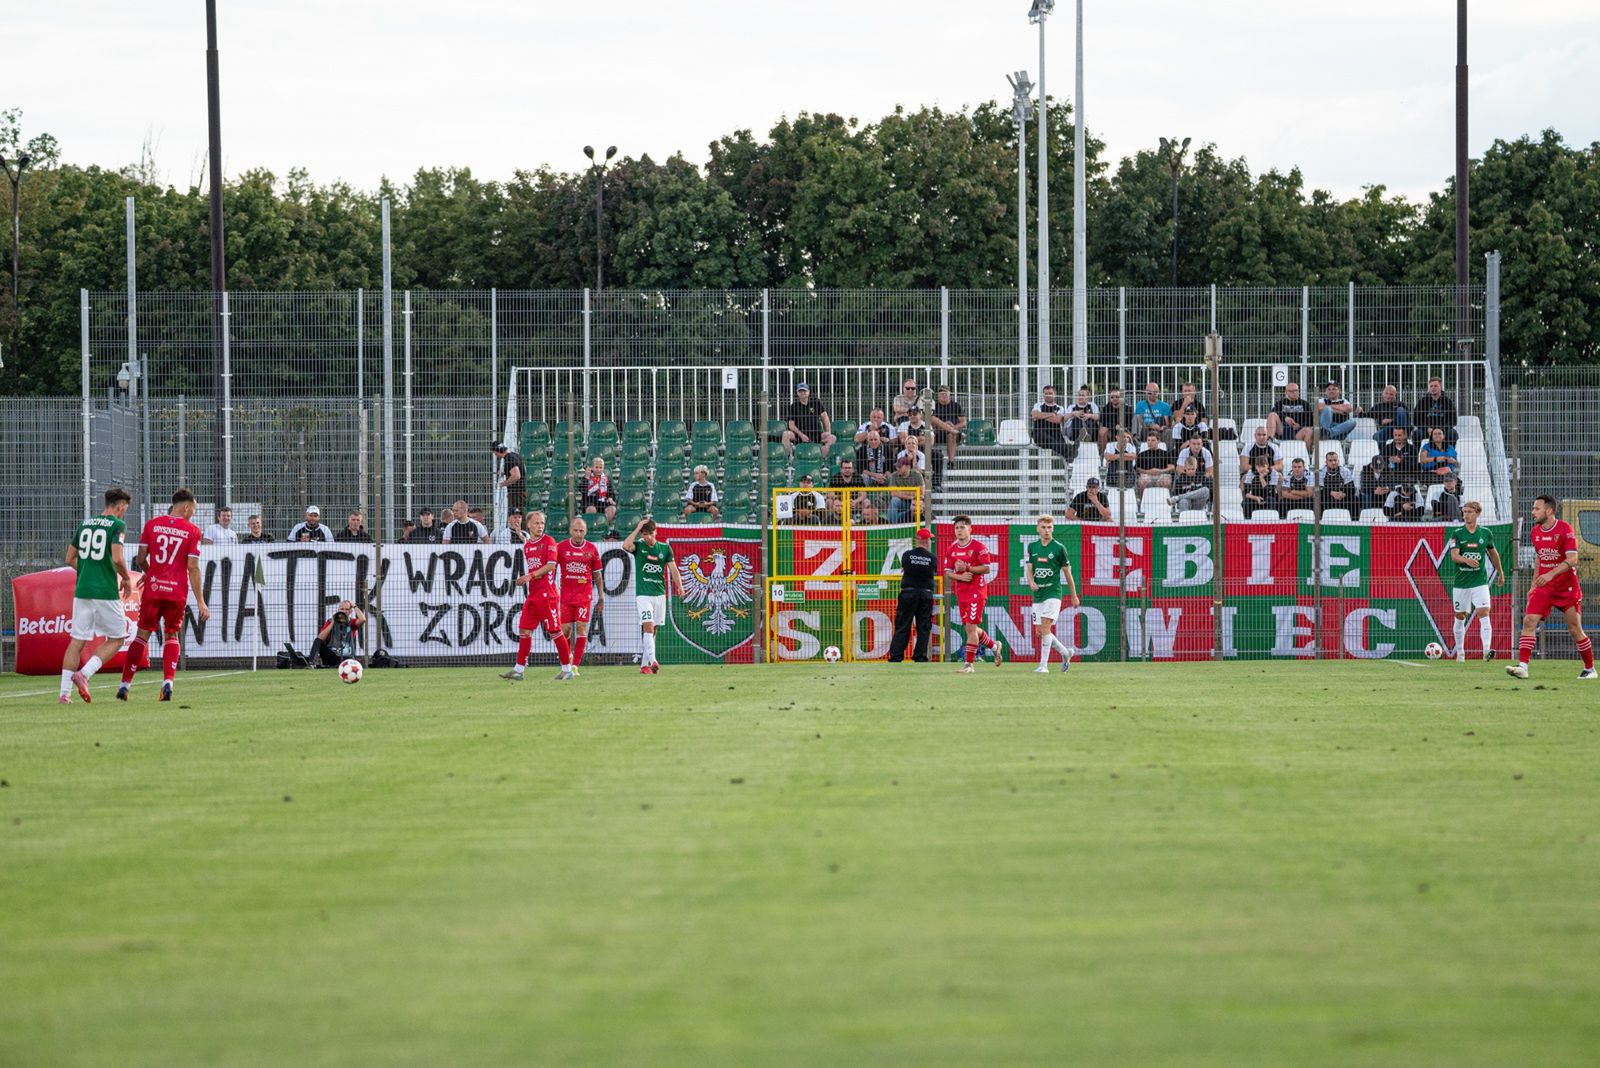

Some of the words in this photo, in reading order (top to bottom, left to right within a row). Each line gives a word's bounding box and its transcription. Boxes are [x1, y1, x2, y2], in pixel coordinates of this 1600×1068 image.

[726, 373, 734, 384] F
[1275, 370, 1285, 381] G
[78, 528, 107, 561] 99
[154, 534, 183, 565] 37
[773, 589, 783, 597] 10
[578, 607, 588, 619] 92
[641, 610, 652, 621] 29
[19, 614, 73, 635] Betclic
